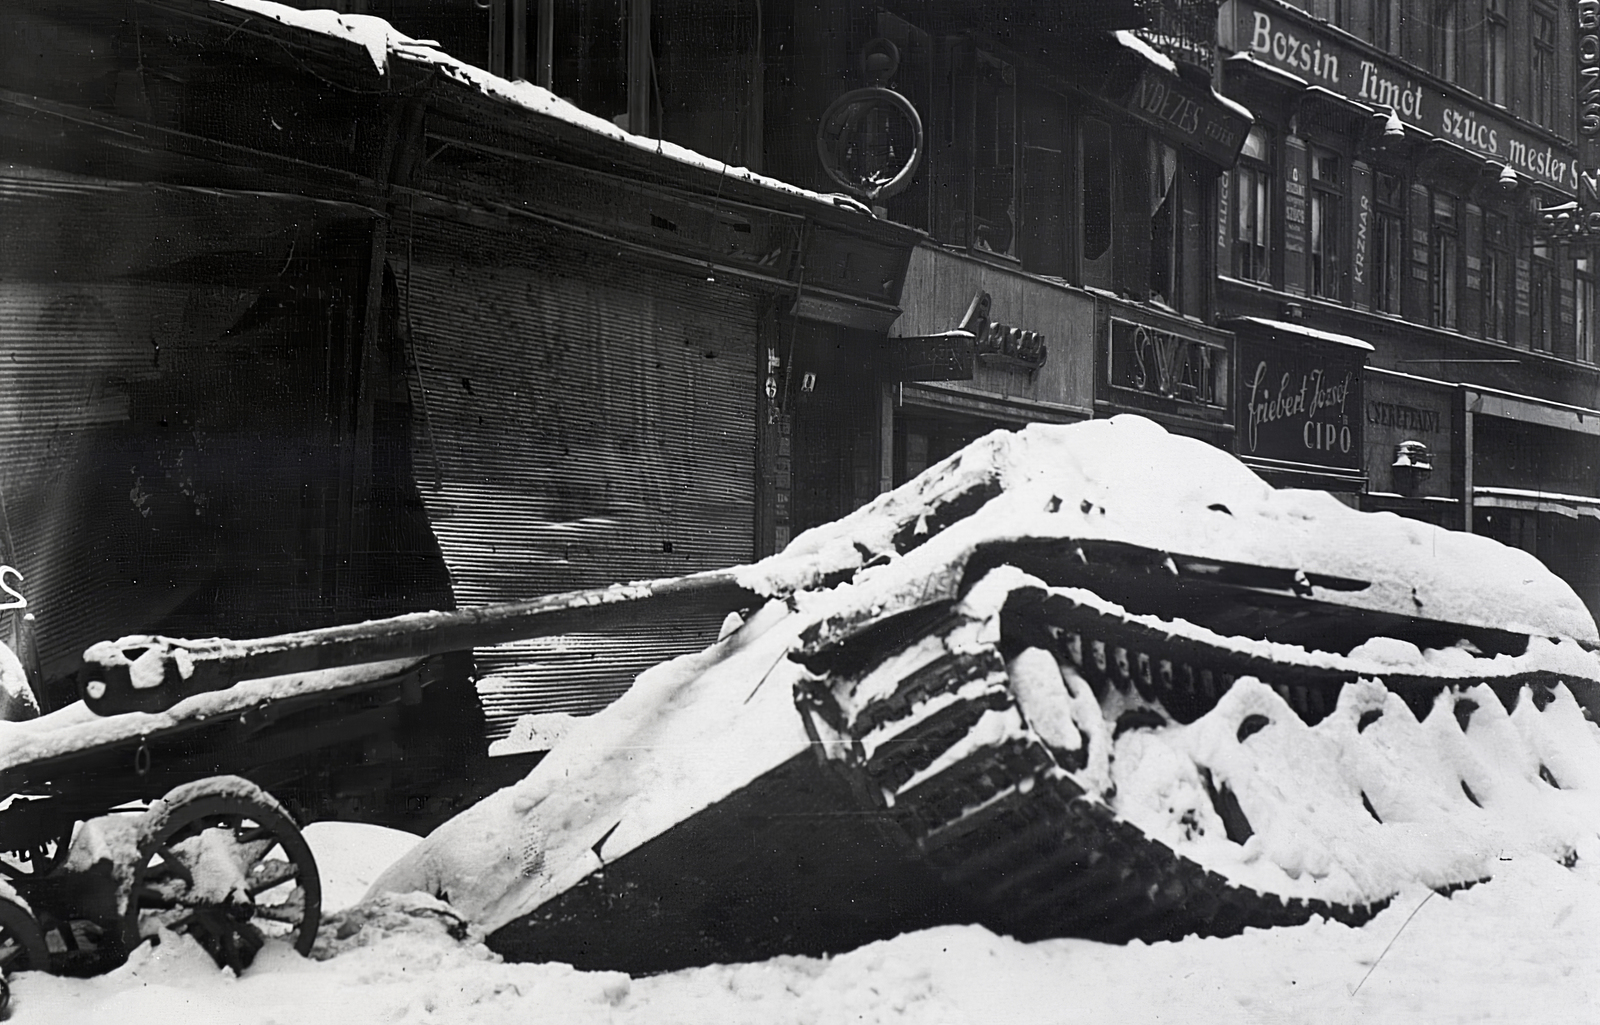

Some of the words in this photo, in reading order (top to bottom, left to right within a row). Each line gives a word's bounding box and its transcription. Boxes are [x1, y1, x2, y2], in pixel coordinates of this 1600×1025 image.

[1253, 11, 1339, 83] Bozsin
[1358, 60, 1423, 120] Timót
[1509, 139, 1567, 183] mester
[1353, 194, 1369, 283] KRZNAR
